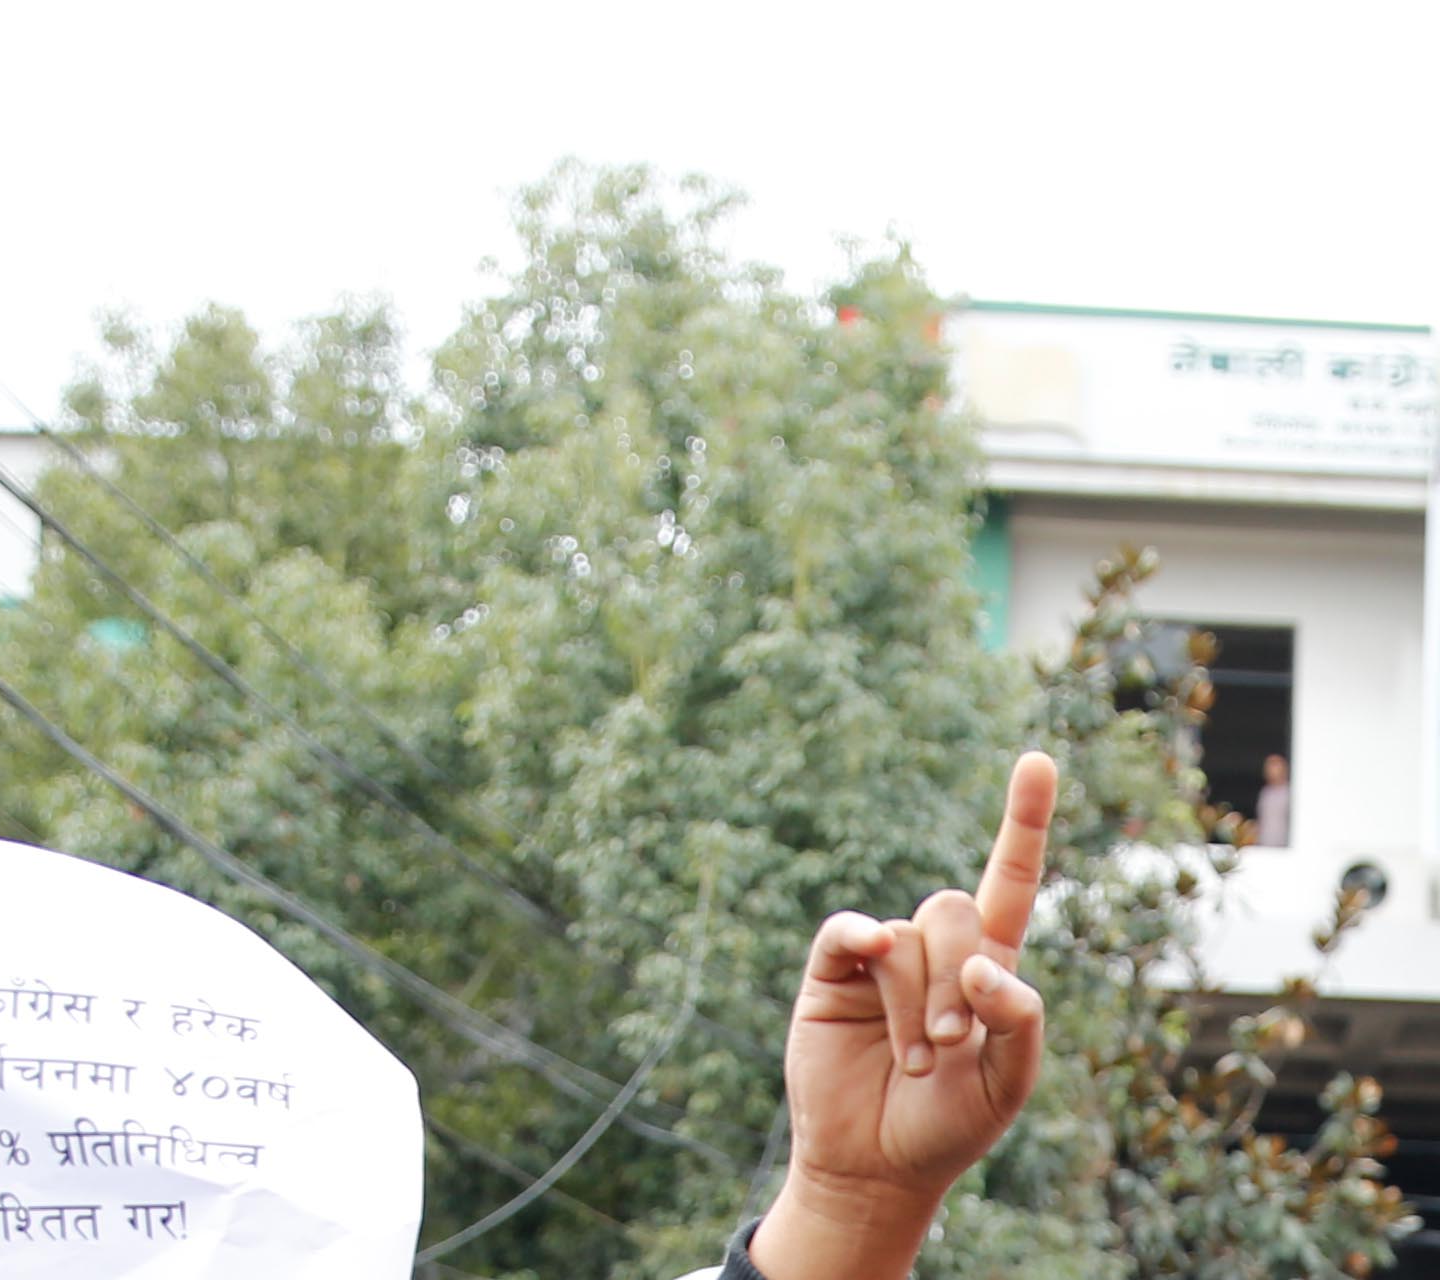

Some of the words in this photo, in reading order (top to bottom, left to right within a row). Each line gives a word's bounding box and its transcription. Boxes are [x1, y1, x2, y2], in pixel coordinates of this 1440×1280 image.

[124, 999, 147, 1029] र
[170, 999, 262, 1043] हरेक
[165, 1066, 296, 1110] ४०वर्ष
[47, 1117, 266, 1169] प्रतिनिधित्व
[123, 1200, 189, 1240] गर!
